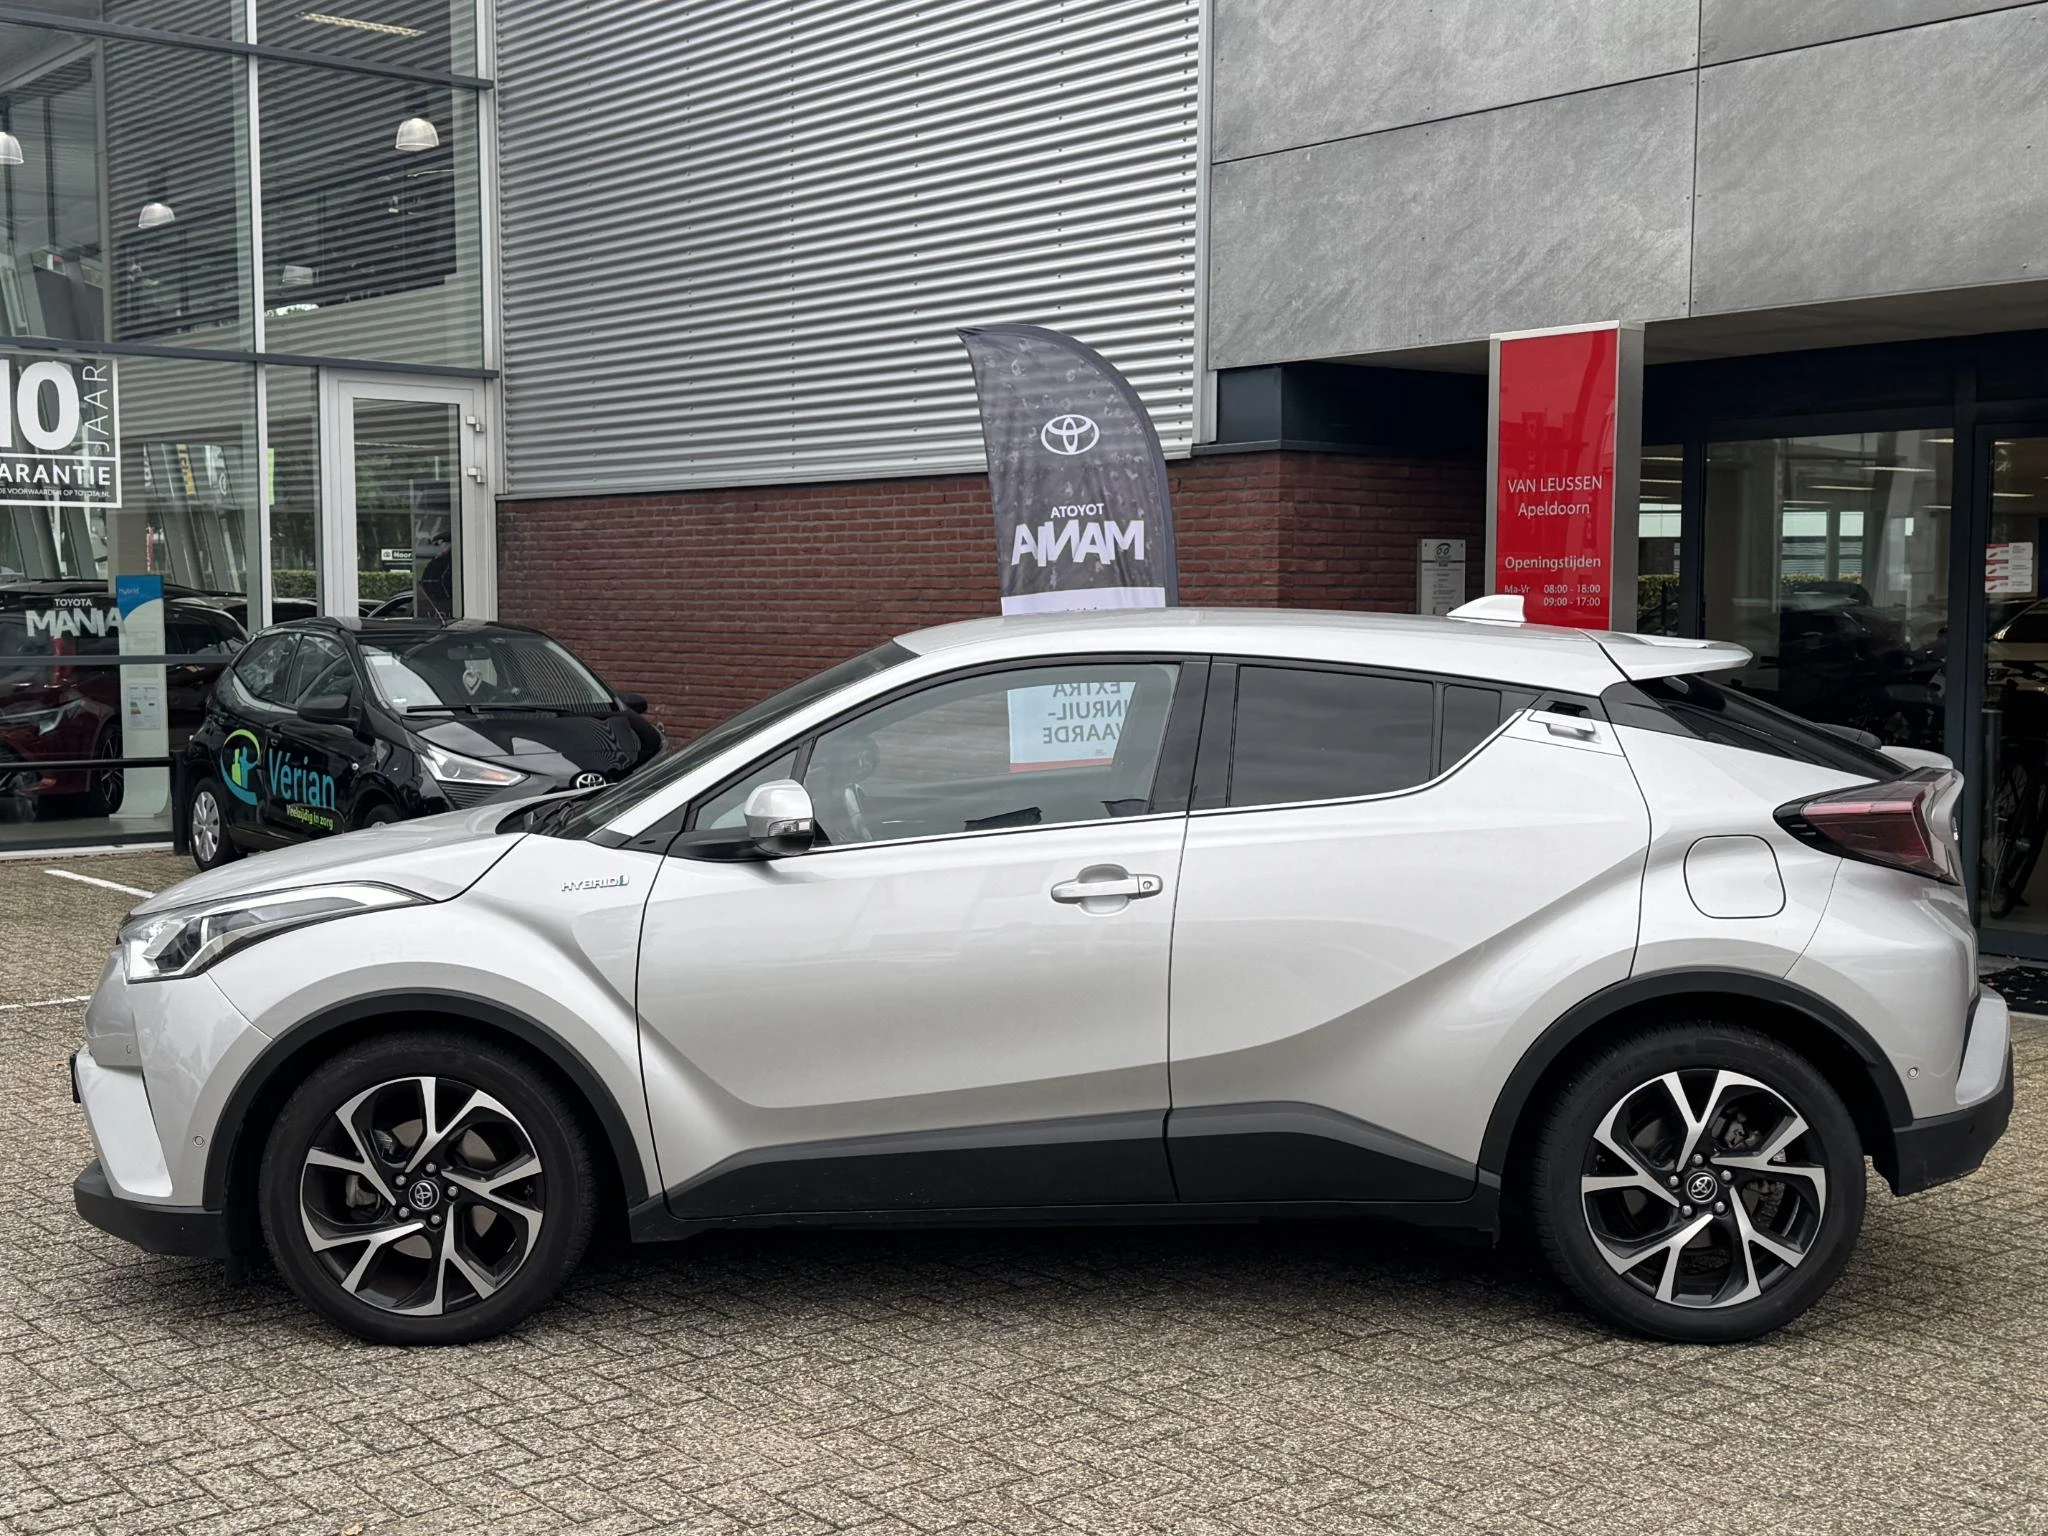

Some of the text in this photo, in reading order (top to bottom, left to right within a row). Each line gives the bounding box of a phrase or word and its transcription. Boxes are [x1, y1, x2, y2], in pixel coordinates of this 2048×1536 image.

[0, 359, 80, 451] 10
[82, 364, 110, 452] JAAR
[0, 463, 111, 486] ARANTIE
[1508, 475, 1602, 493] VAN LEUSSEN
[1518, 501, 1590, 519] Apeldoorn
[1504, 555, 1601, 572] Openingstijden
[1504, 584, 1530, 594] Ma-Vr
[1543, 584, 1568, 594] 08:00
[1577, 584, 1601, 593] 18:00
[54, 598, 93, 607] TOYOTA
[1543, 597, 1568, 606] 09:00
[1576, 597, 1601, 606] 17:00
[25, 606, 126, 637] MANIA
[269, 748, 335, 810] Vérian
[320, 816, 334, 830] zorg
[560, 877, 621, 892] HYBRID
